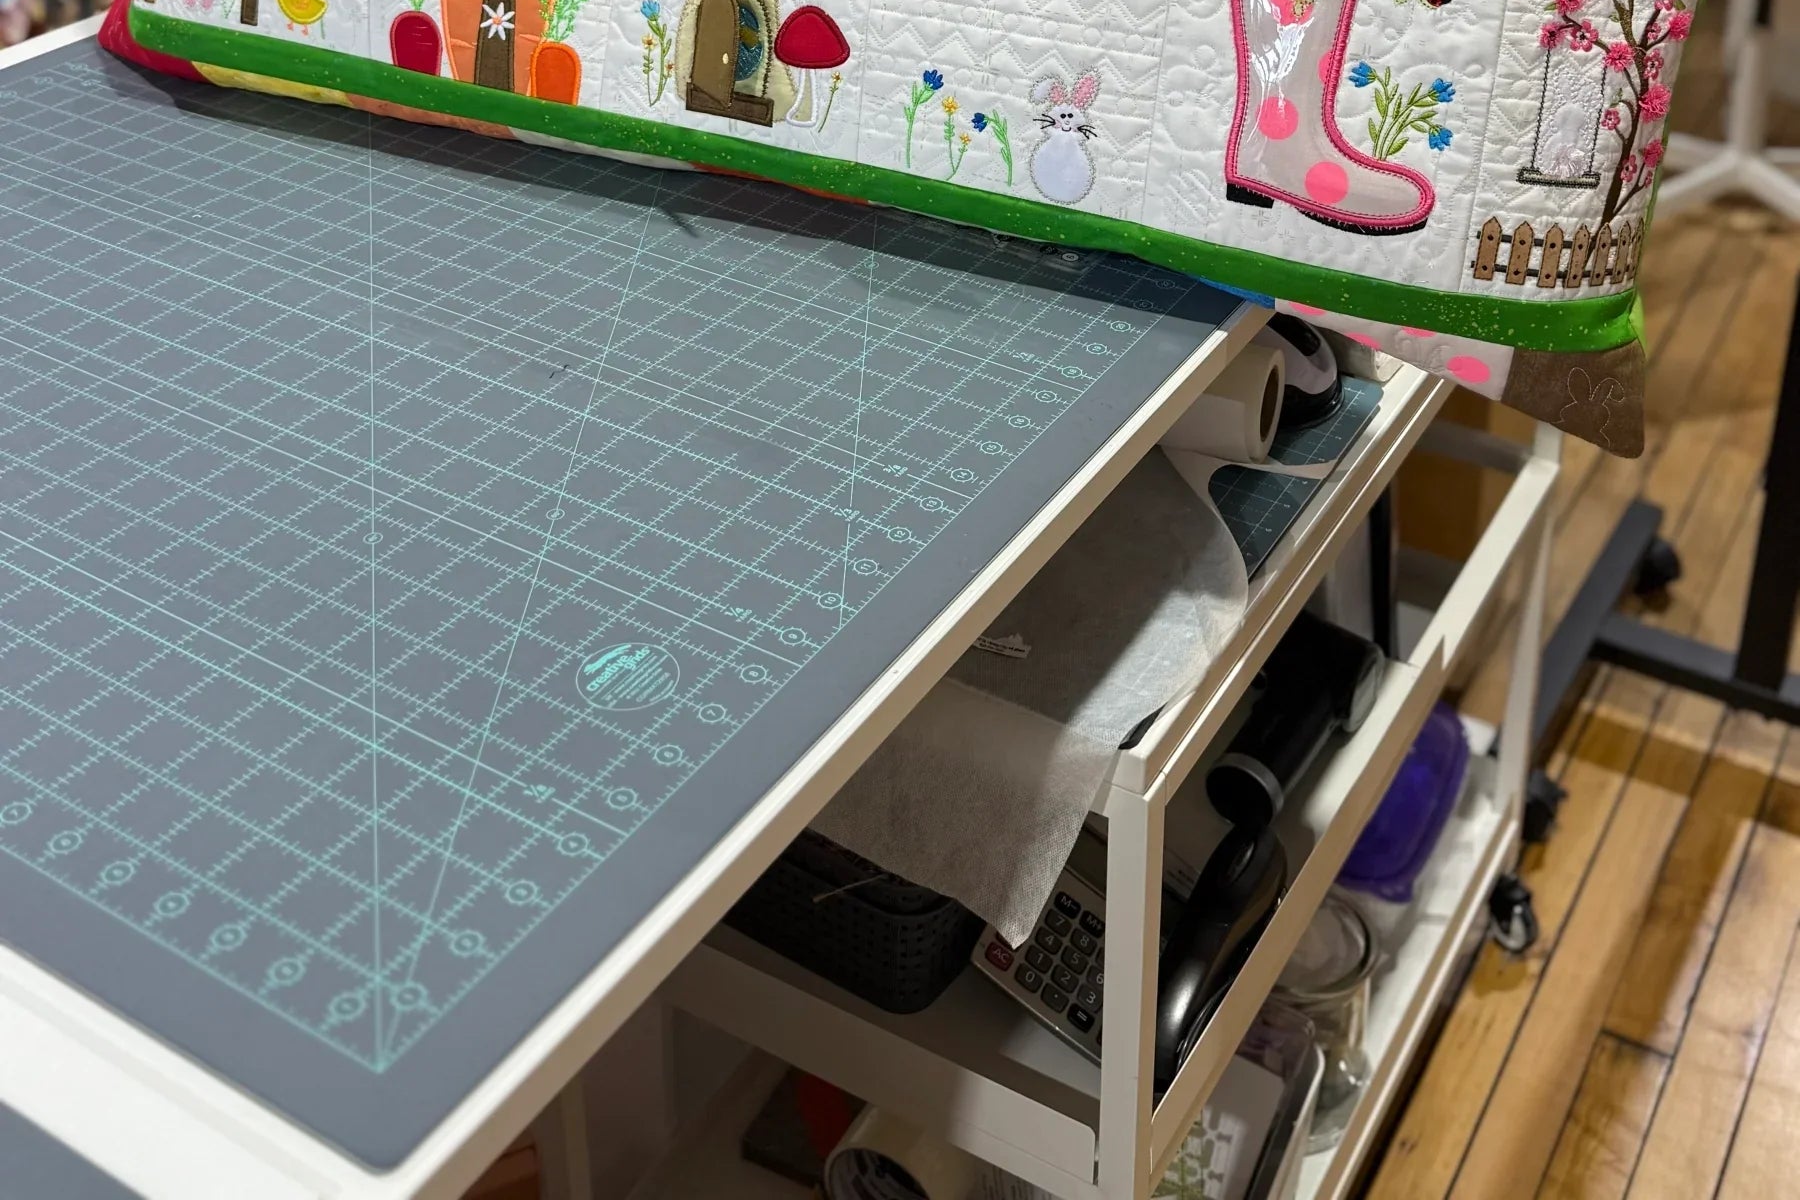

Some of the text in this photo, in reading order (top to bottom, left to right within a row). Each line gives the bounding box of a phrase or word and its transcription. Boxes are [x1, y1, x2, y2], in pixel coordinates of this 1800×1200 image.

[623, 645, 651, 672] grids
[586, 654, 630, 692] creative
[993, 948, 1009, 960] AC
[1086, 991, 1097, 1004] 3
